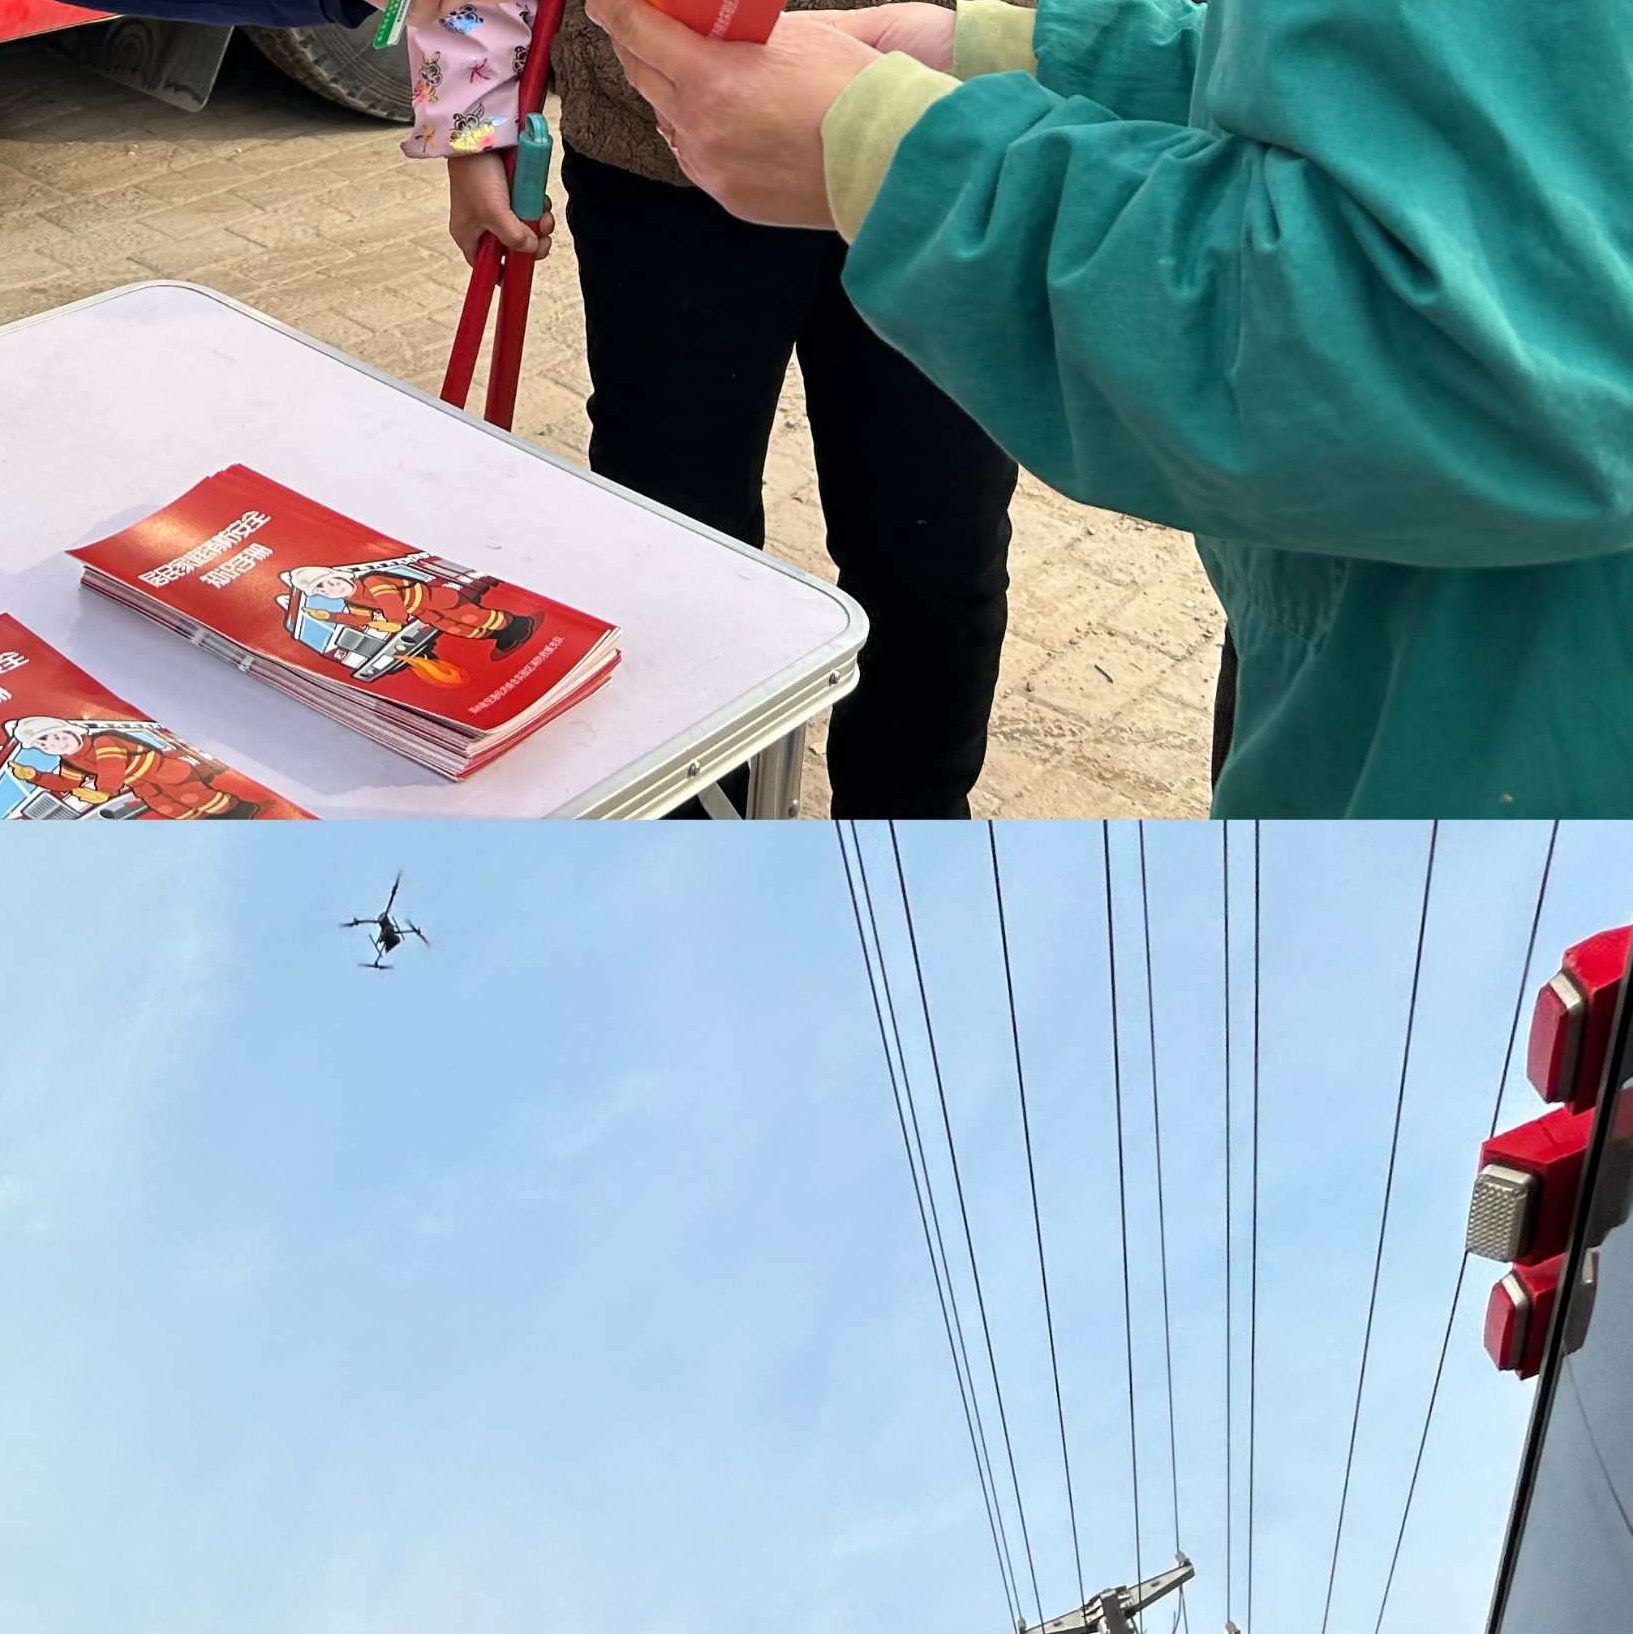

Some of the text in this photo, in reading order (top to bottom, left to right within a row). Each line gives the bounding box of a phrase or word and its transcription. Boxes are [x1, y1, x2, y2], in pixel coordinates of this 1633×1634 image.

[138, 510, 272, 589] 居民家庭消防安全
[199, 542, 274, 589] 知识手册
